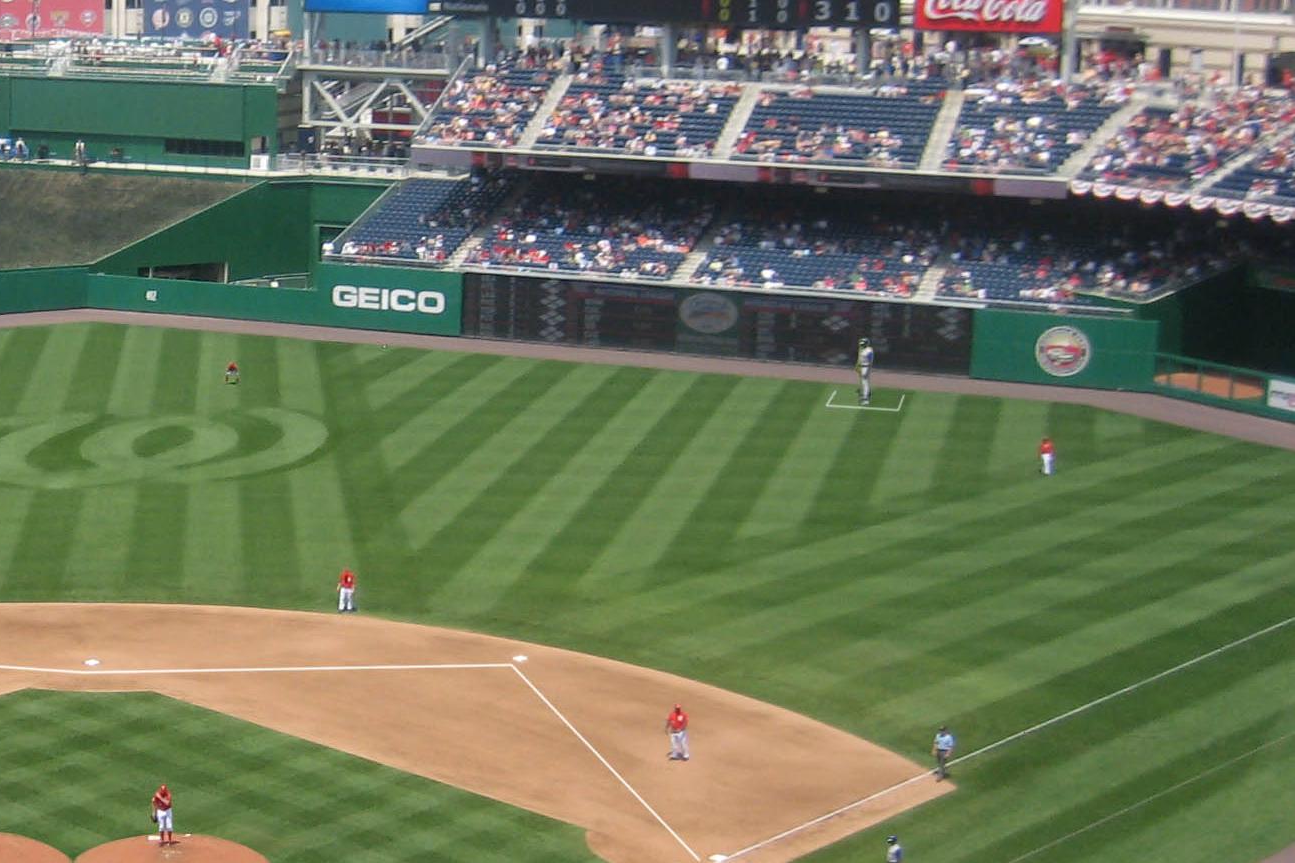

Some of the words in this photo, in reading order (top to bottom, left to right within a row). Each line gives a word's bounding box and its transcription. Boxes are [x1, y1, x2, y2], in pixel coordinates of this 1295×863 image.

[814, 2, 831, 21] 3
[845, 2, 860, 21] 1
[874, 2, 890, 22] 0
[332, 285, 445, 314] GEICO
